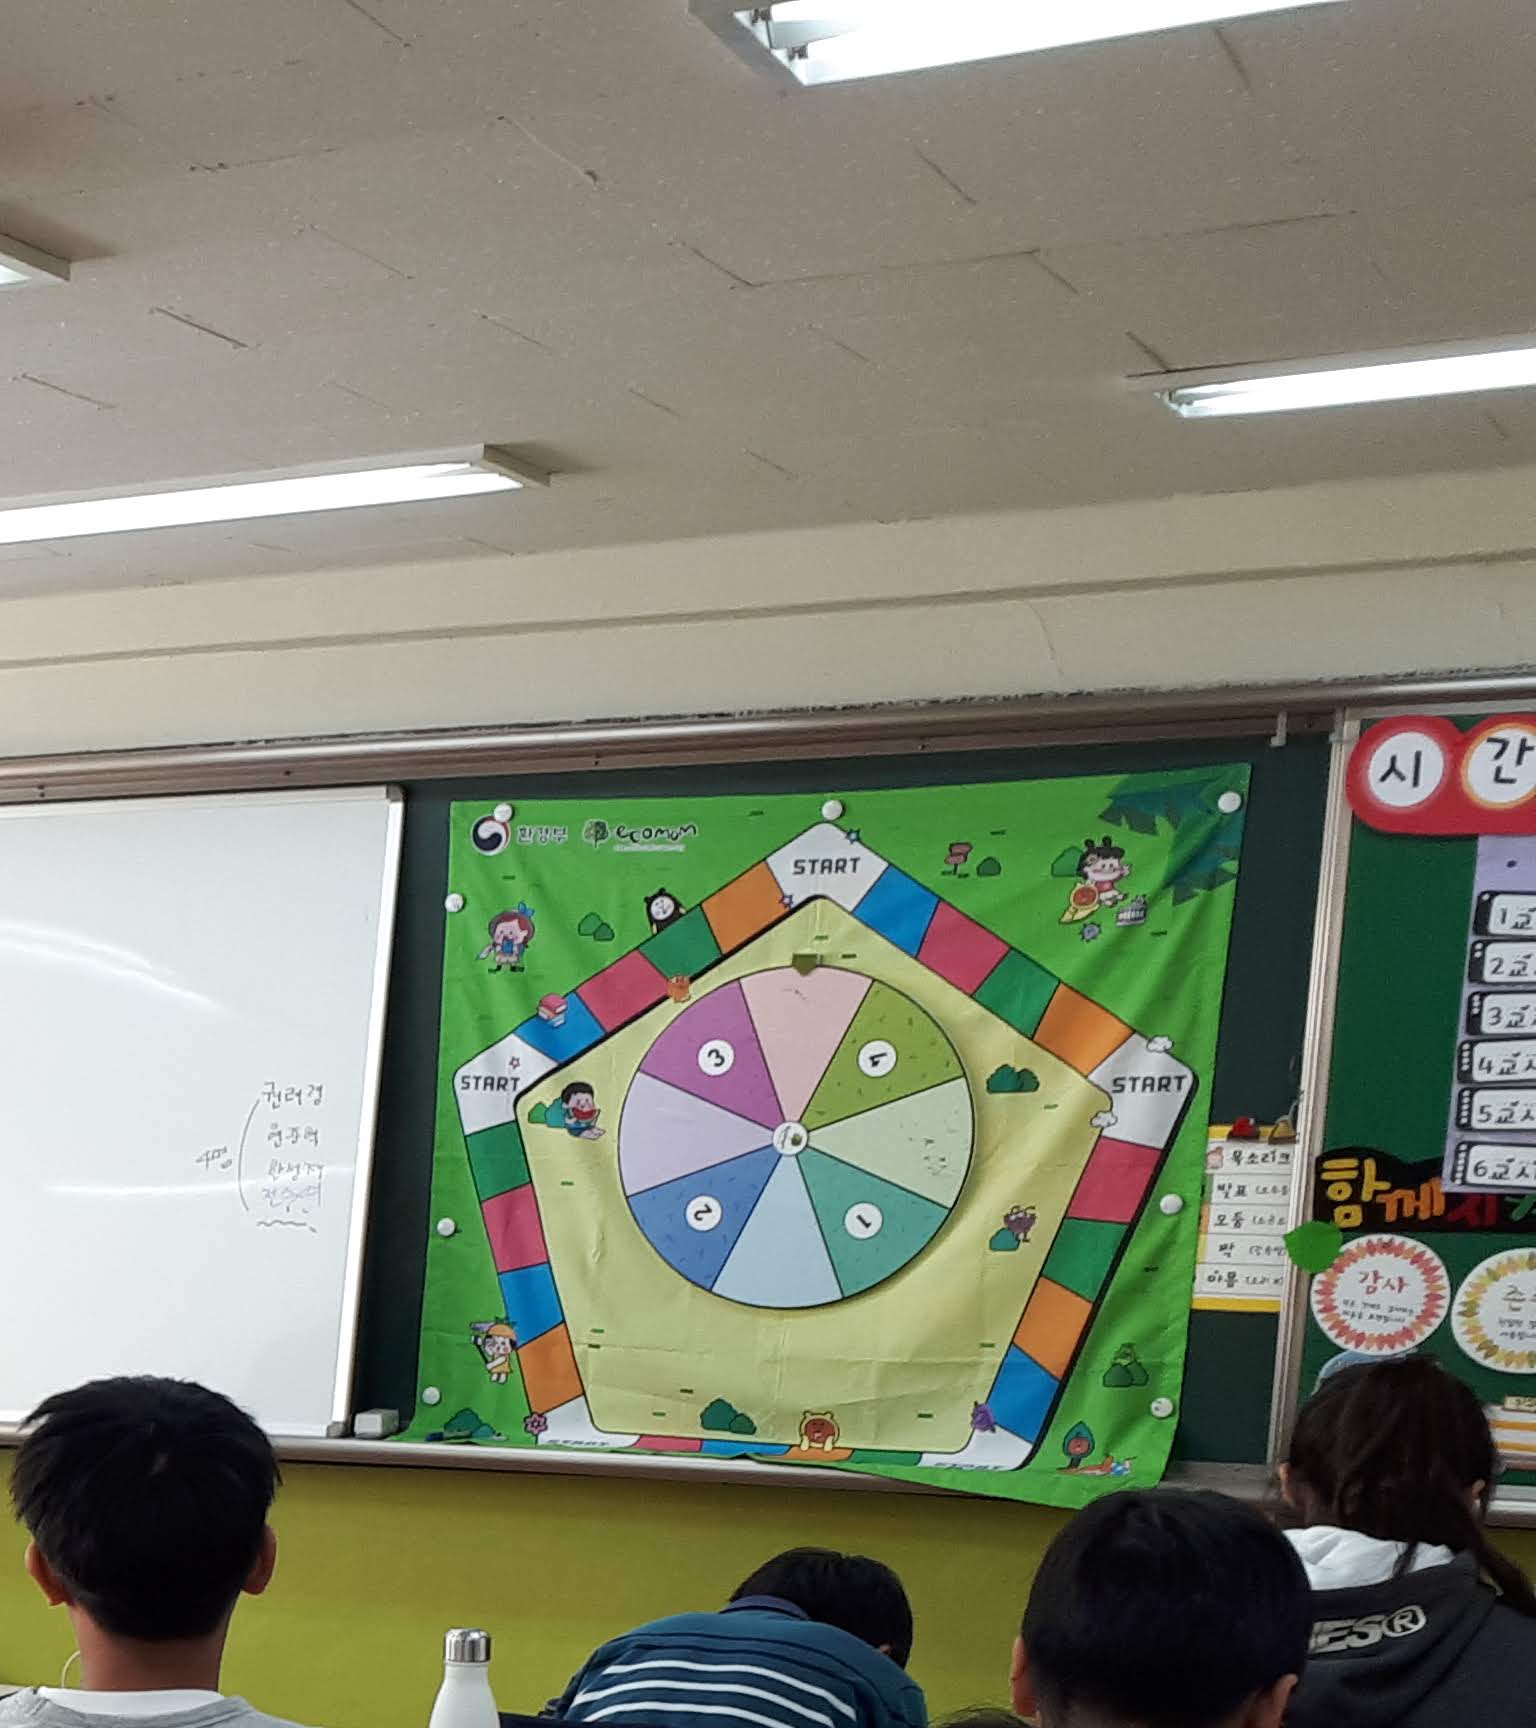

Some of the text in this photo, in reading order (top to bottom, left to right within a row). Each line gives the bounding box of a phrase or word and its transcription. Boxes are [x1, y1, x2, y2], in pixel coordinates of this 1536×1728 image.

[518, 826, 567, 842] 환경부
[616, 823, 698, 843] ecomom
[792, 857, 861, 875] START
[1489, 954, 1536, 976] 2교
[1488, 1004, 1536, 1028] 3교
[707, 1049, 726, 1068] 3
[868, 1052, 888, 1068] 4
[461, 1075, 520, 1092] START
[1111, 1075, 1187, 1093] START
[1217, 1183, 1248, 1199] 발표
[694, 1204, 713, 1221] 2
[856, 1213, 872, 1229] 1
[1214, 1211, 1245, 1229] 모둠
[1359, 1270, 1410, 1295] 감사
